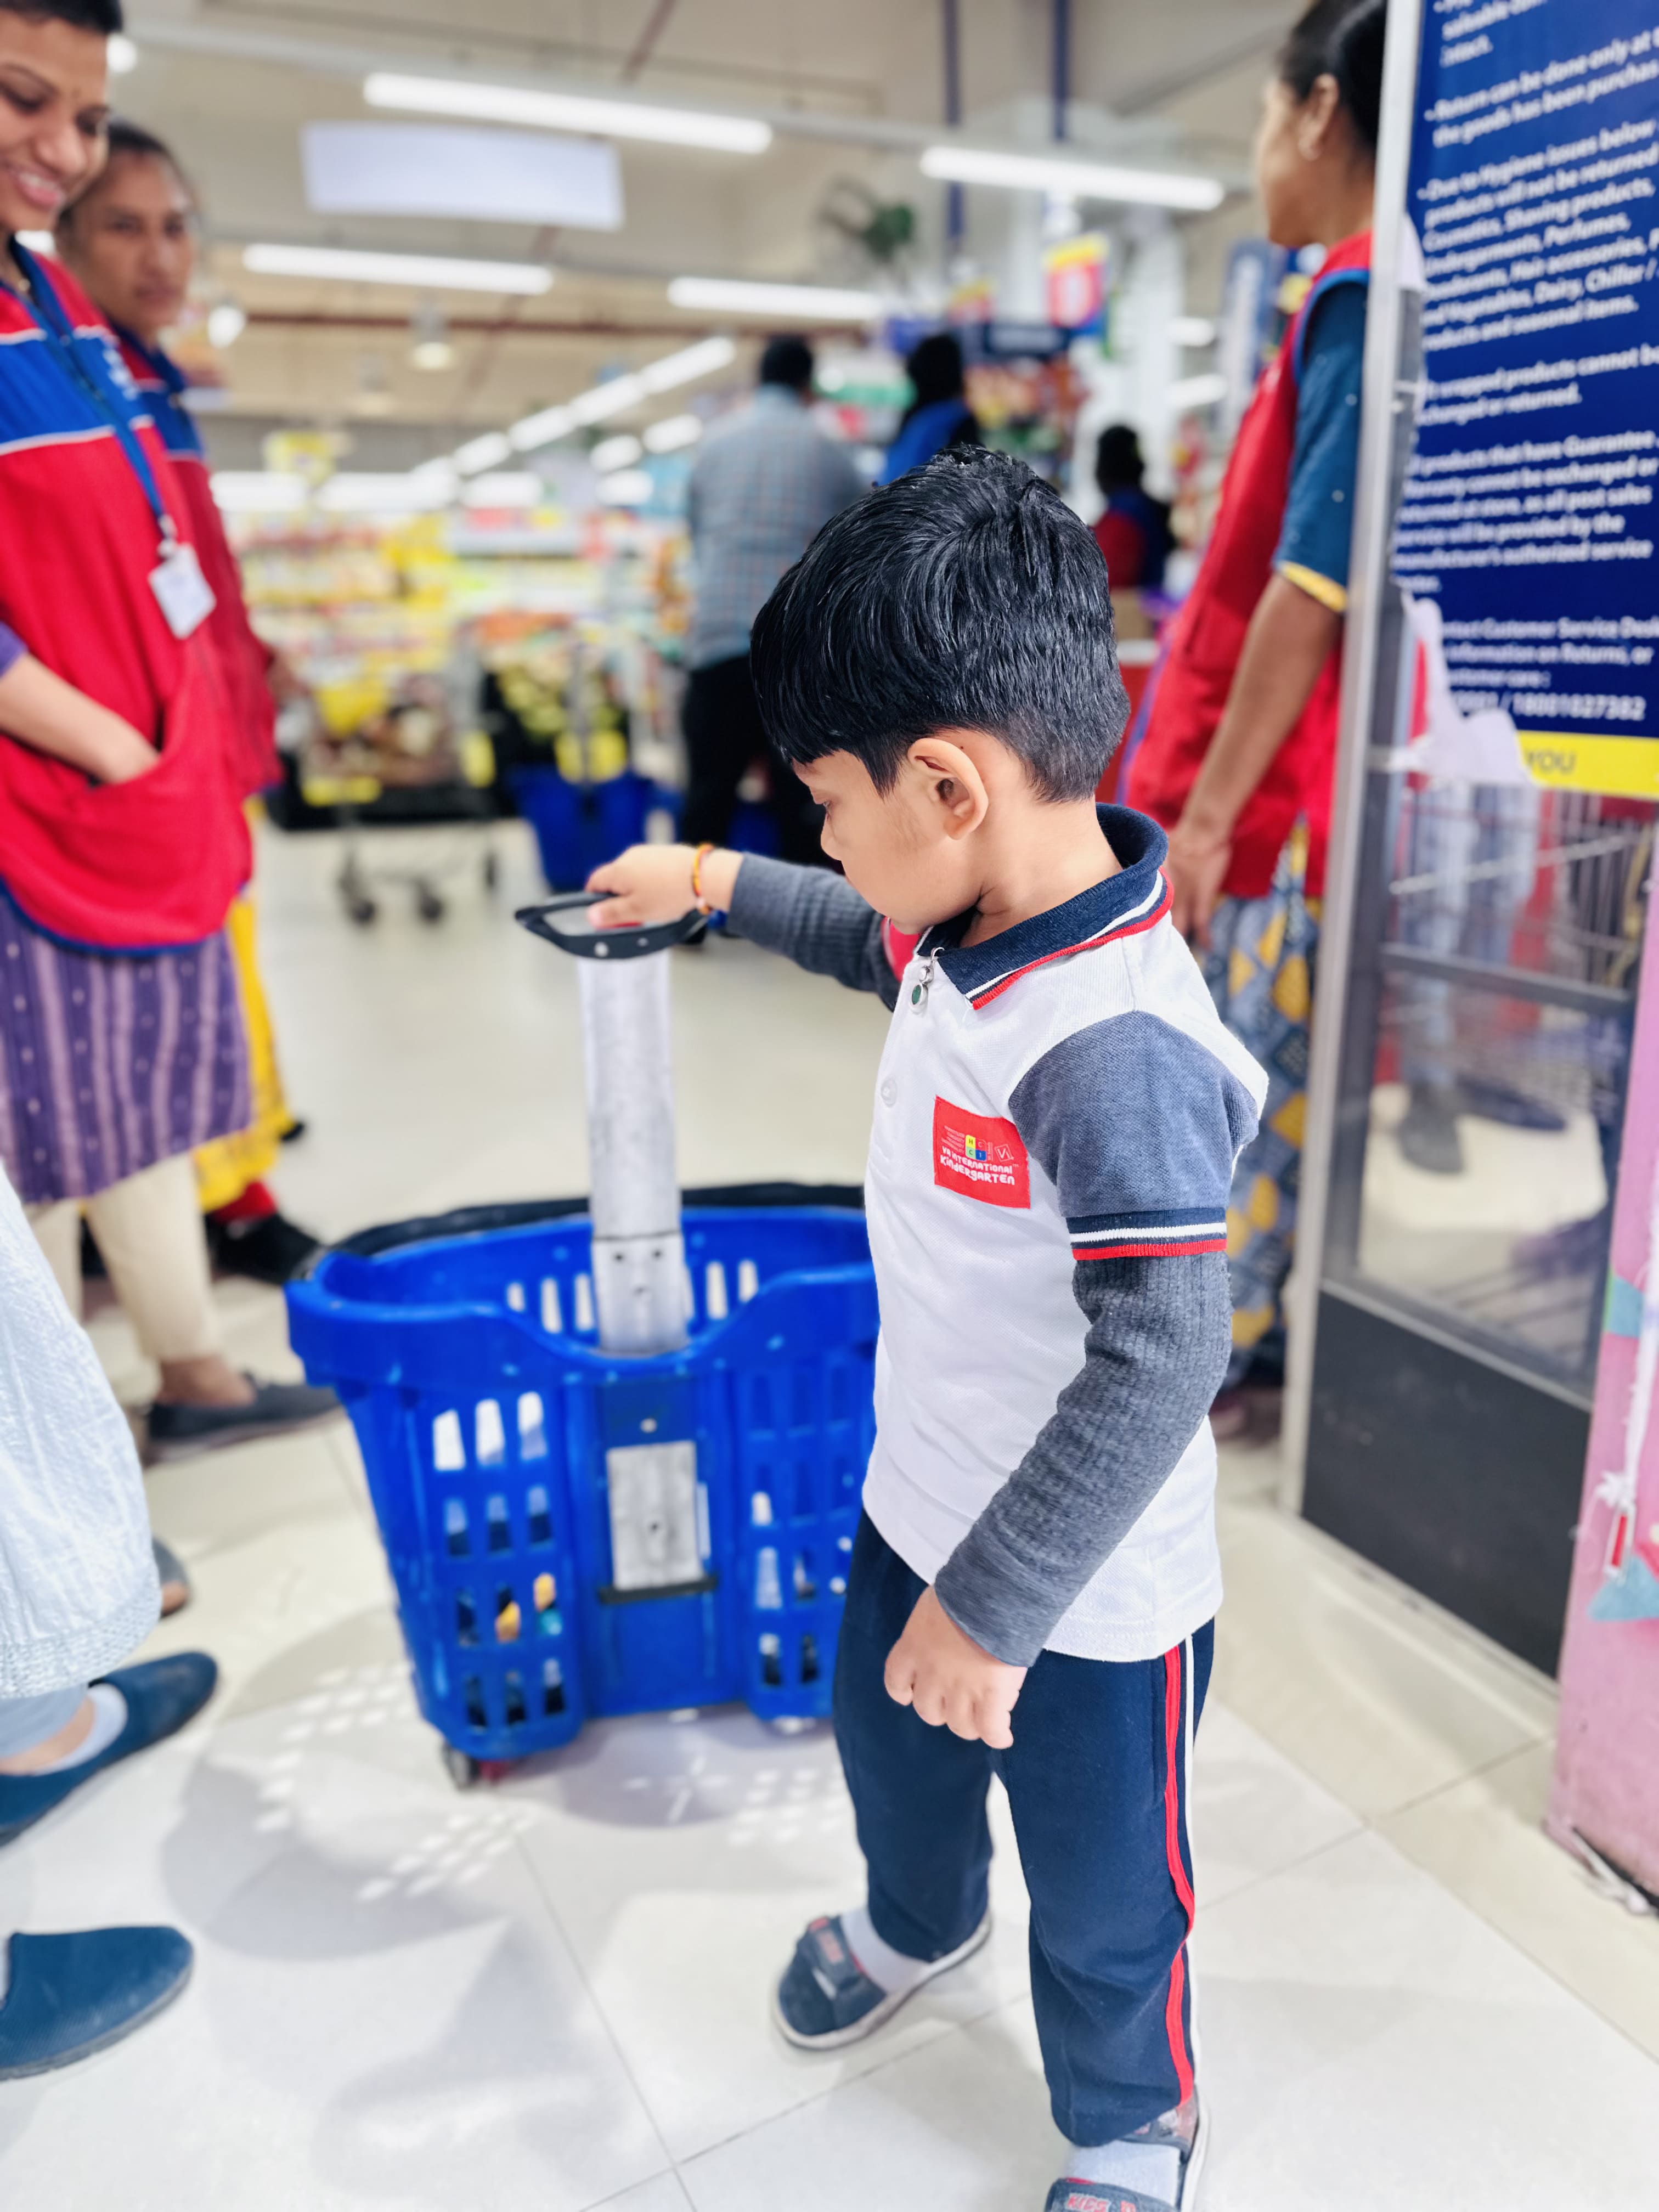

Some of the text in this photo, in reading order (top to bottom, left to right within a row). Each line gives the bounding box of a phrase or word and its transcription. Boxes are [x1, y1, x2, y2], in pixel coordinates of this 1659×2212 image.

[1490, 81, 1517, 103] can
[1520, 72, 1541, 92] be
[1543, 56, 1586, 84] done
[1589, 41, 1628, 69] only
[1630, 32, 1650, 54] at
[1434, 127, 1460, 146] the
[1463, 109, 1510, 142] goods
[1513, 100, 1541, 121] has
[1543, 85, 1584, 112] been
[1427, 179, 1459, 199] Due
[1461, 173, 1479, 190] to
[1547, 137, 1597, 165] issues
[1600, 121, 1656, 150] below
[1425, 143, 1658, 228] products will not be returned
[1505, 200, 1569, 230] Shaving
[1586, 265, 1643, 291] Chiller
[1481, 318, 1513, 340] and
[1506, 360, 1576, 390] products
[1578, 349, 1638, 375] cannot
[1489, 446, 1519, 465] that
[1523, 442, 1562, 461] have
[1565, 431, 1654, 457] Guarantee
[1466, 471, 1519, 493] cannot
[1522, 469, 1542, 487] be
[1544, 456, 1637, 485] exchanged
[1639, 458, 1657, 476] or
[1524, 497, 1543, 512] as
[1607, 484, 1652, 506] sales
[1594, 514, 1624, 533] the
[1592, 540, 1652, 560] service
[1558, 618, 1618, 638] Service
[1632, 647, 1654, 664] or
